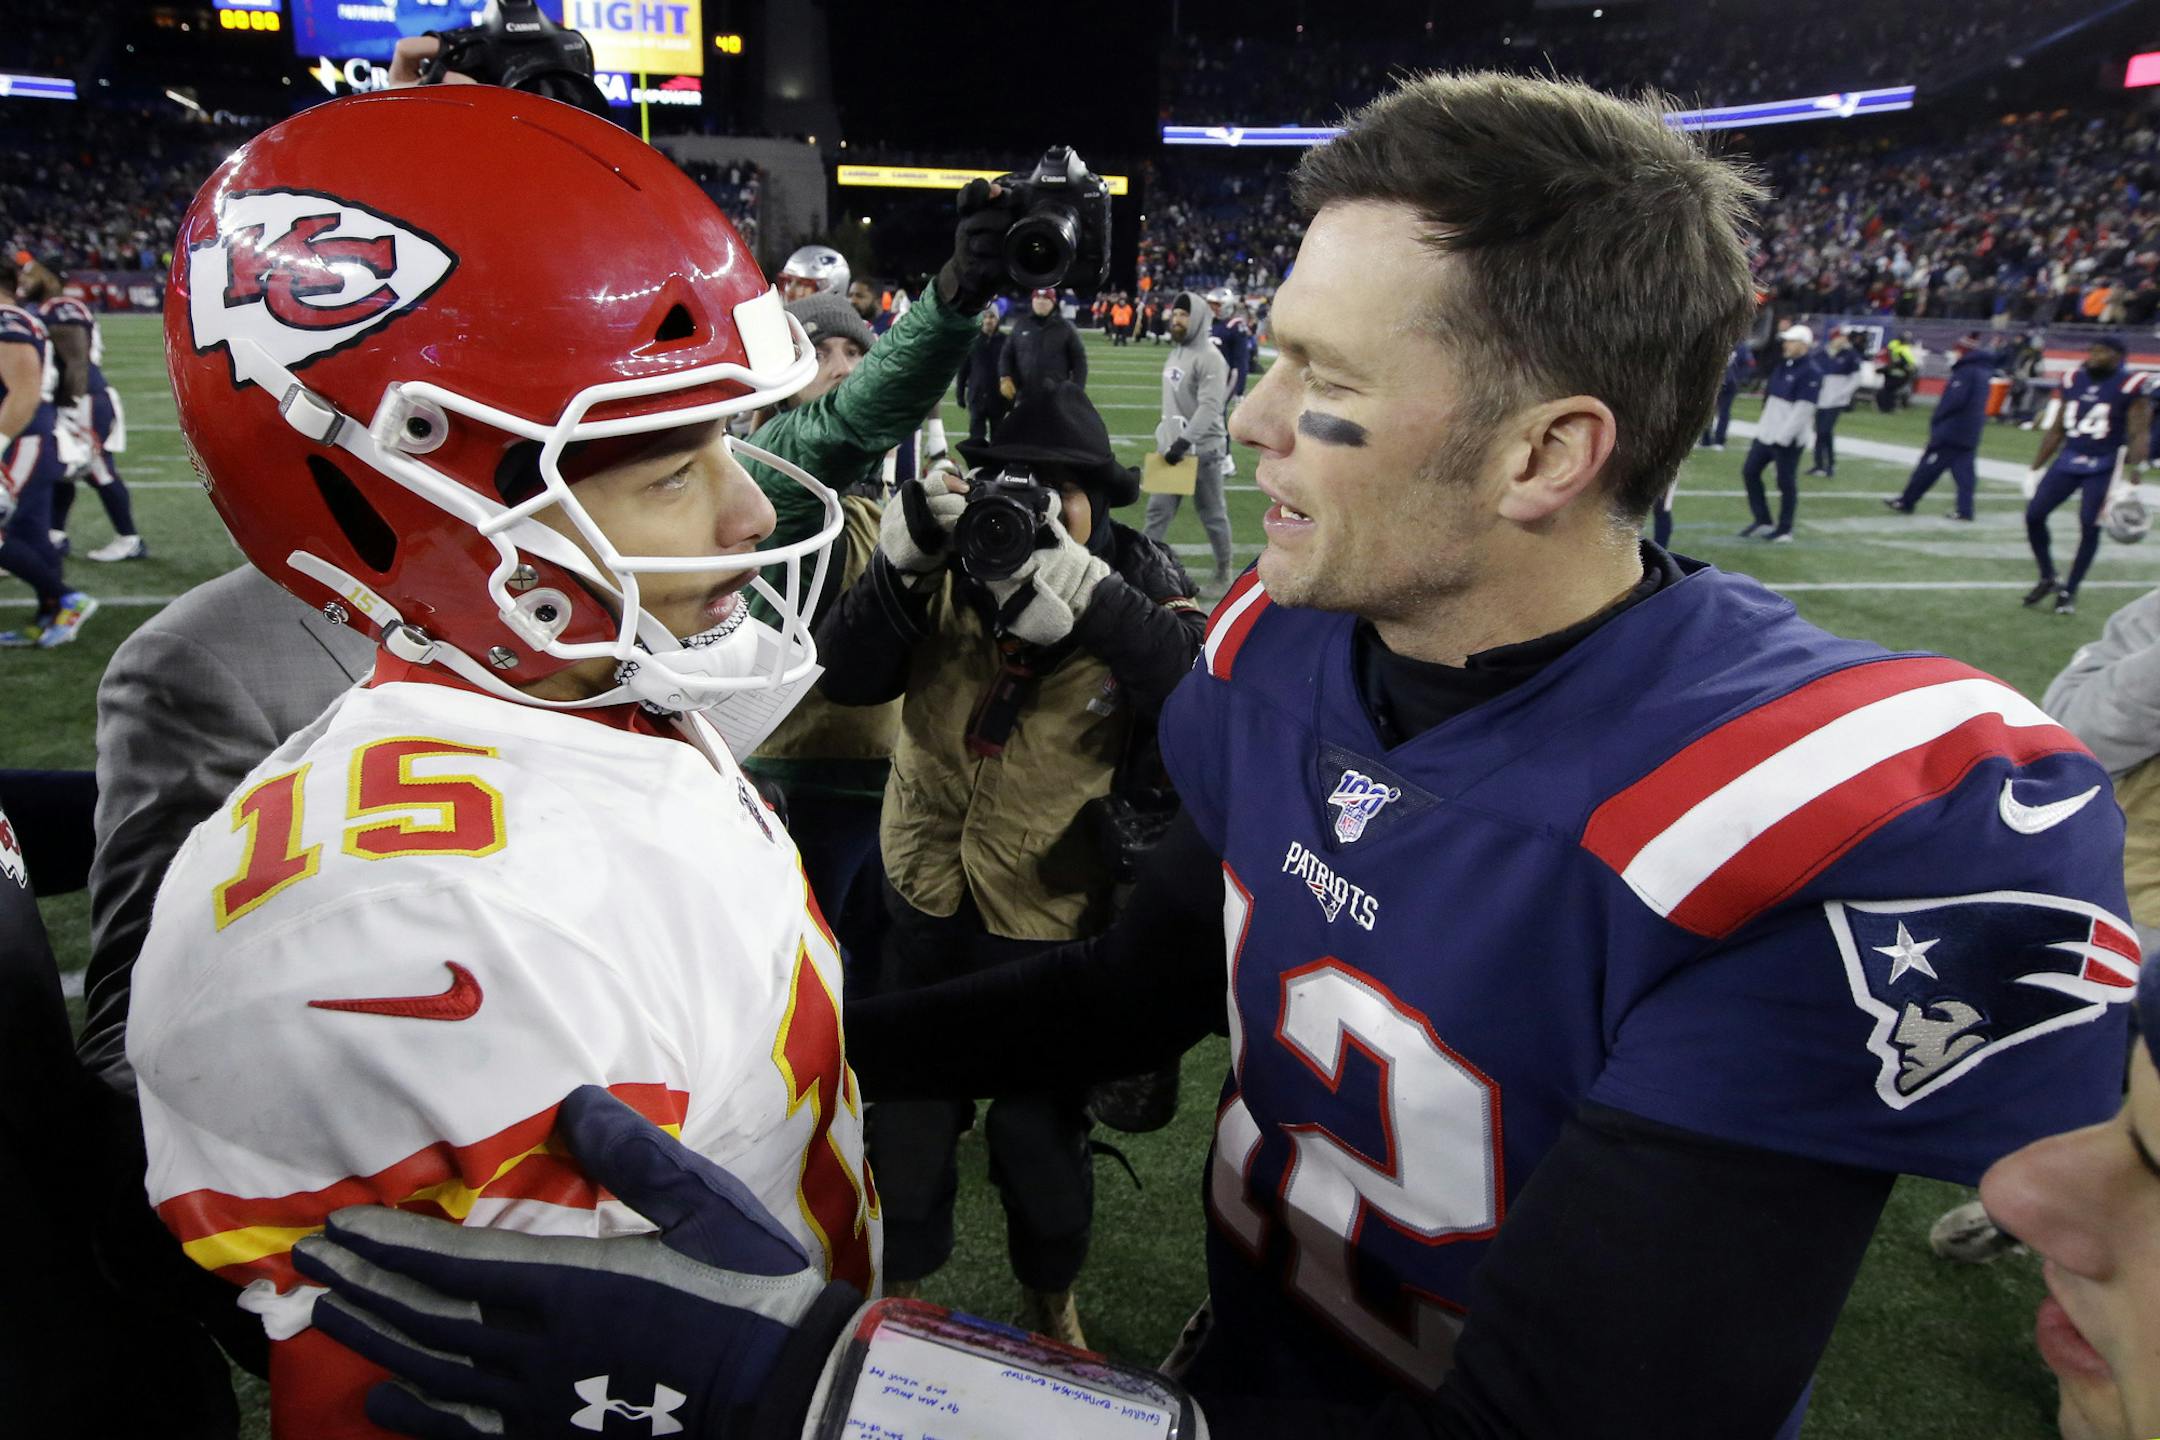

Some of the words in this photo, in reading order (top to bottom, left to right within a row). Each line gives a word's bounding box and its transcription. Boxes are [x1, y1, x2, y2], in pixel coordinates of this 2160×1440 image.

[506, 22, 540, 32] Canon
[575, 1, 689, 35] LIGHT
[1040, 174, 1067, 183] Canon
[223, 212, 400, 331] KC
[2063, 400, 2112, 440] 14
[1004, 475, 1028, 484] Canon
[346, 586, 380, 613] 15
[211, 735, 508, 932] 15
[1281, 840, 1379, 931] PATRIOTS
